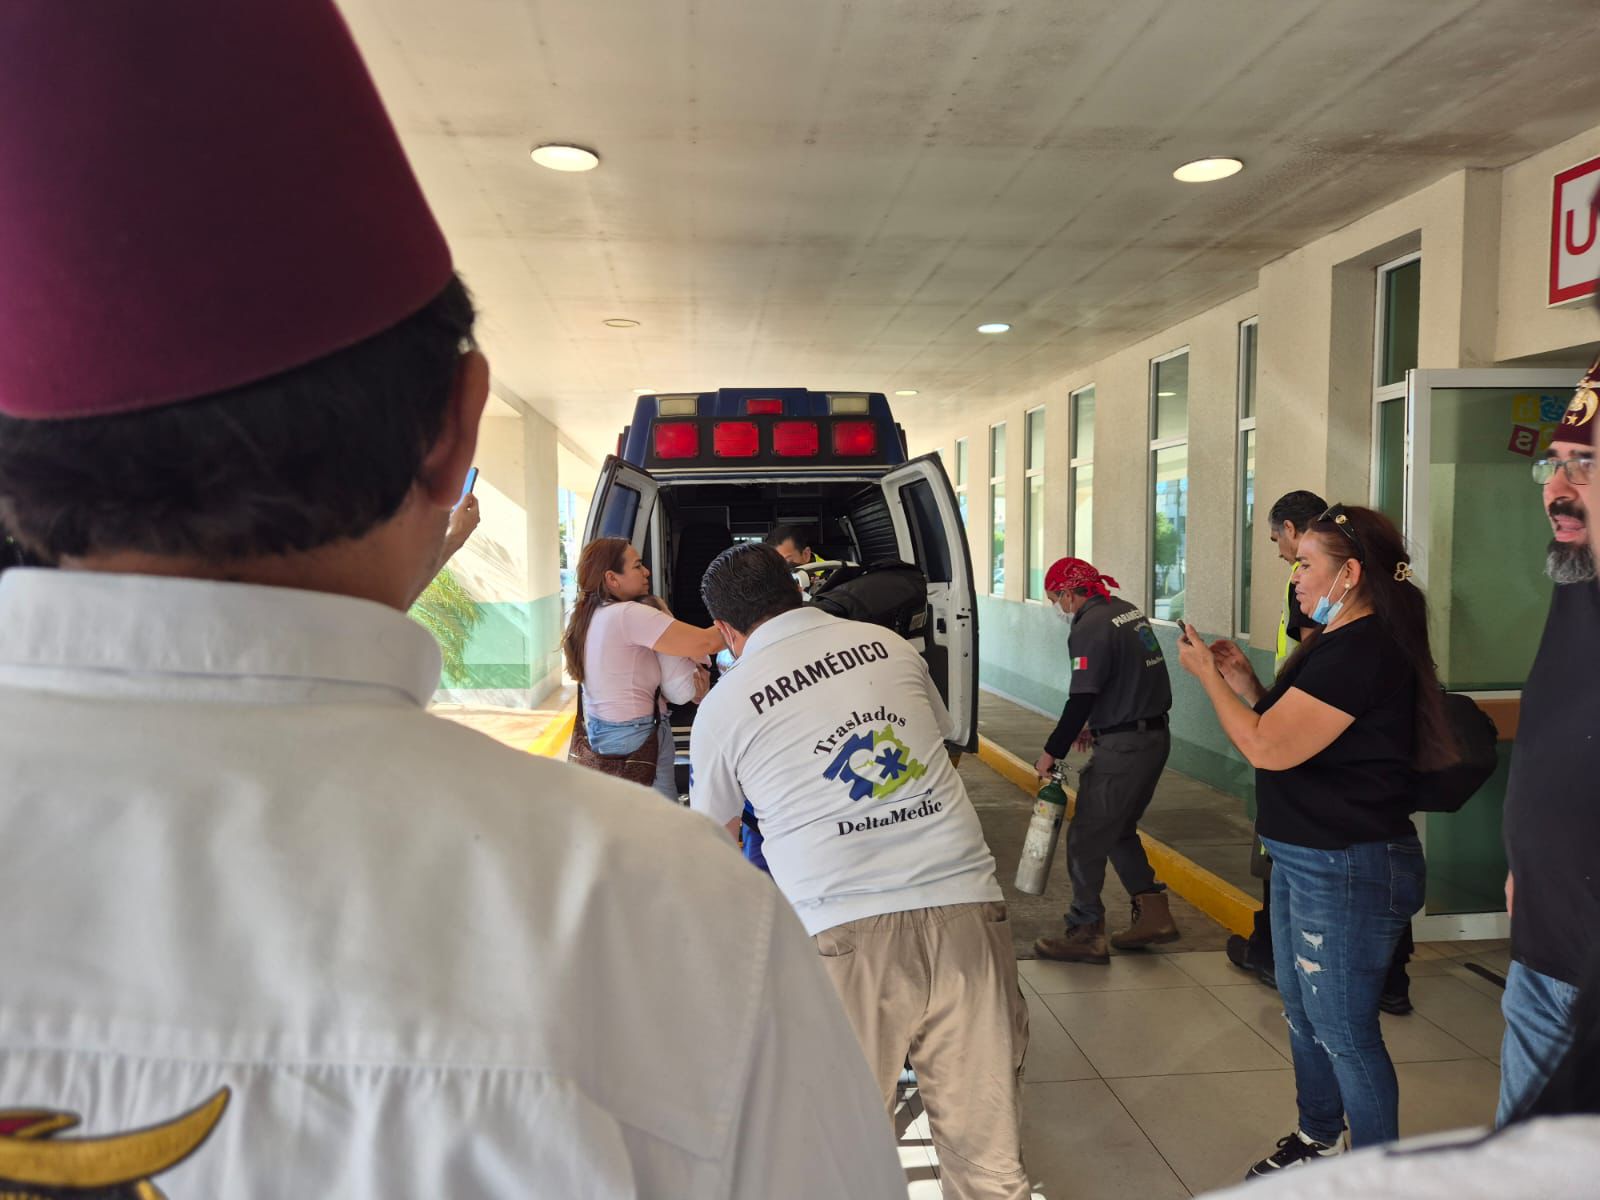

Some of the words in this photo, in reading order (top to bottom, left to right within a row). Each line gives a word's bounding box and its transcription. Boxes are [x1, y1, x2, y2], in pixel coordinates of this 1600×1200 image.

[750, 641, 889, 715] PARAMÉDICO
[813, 705, 906, 757] Traslados
[837, 799, 943, 836] DeltaMedic
